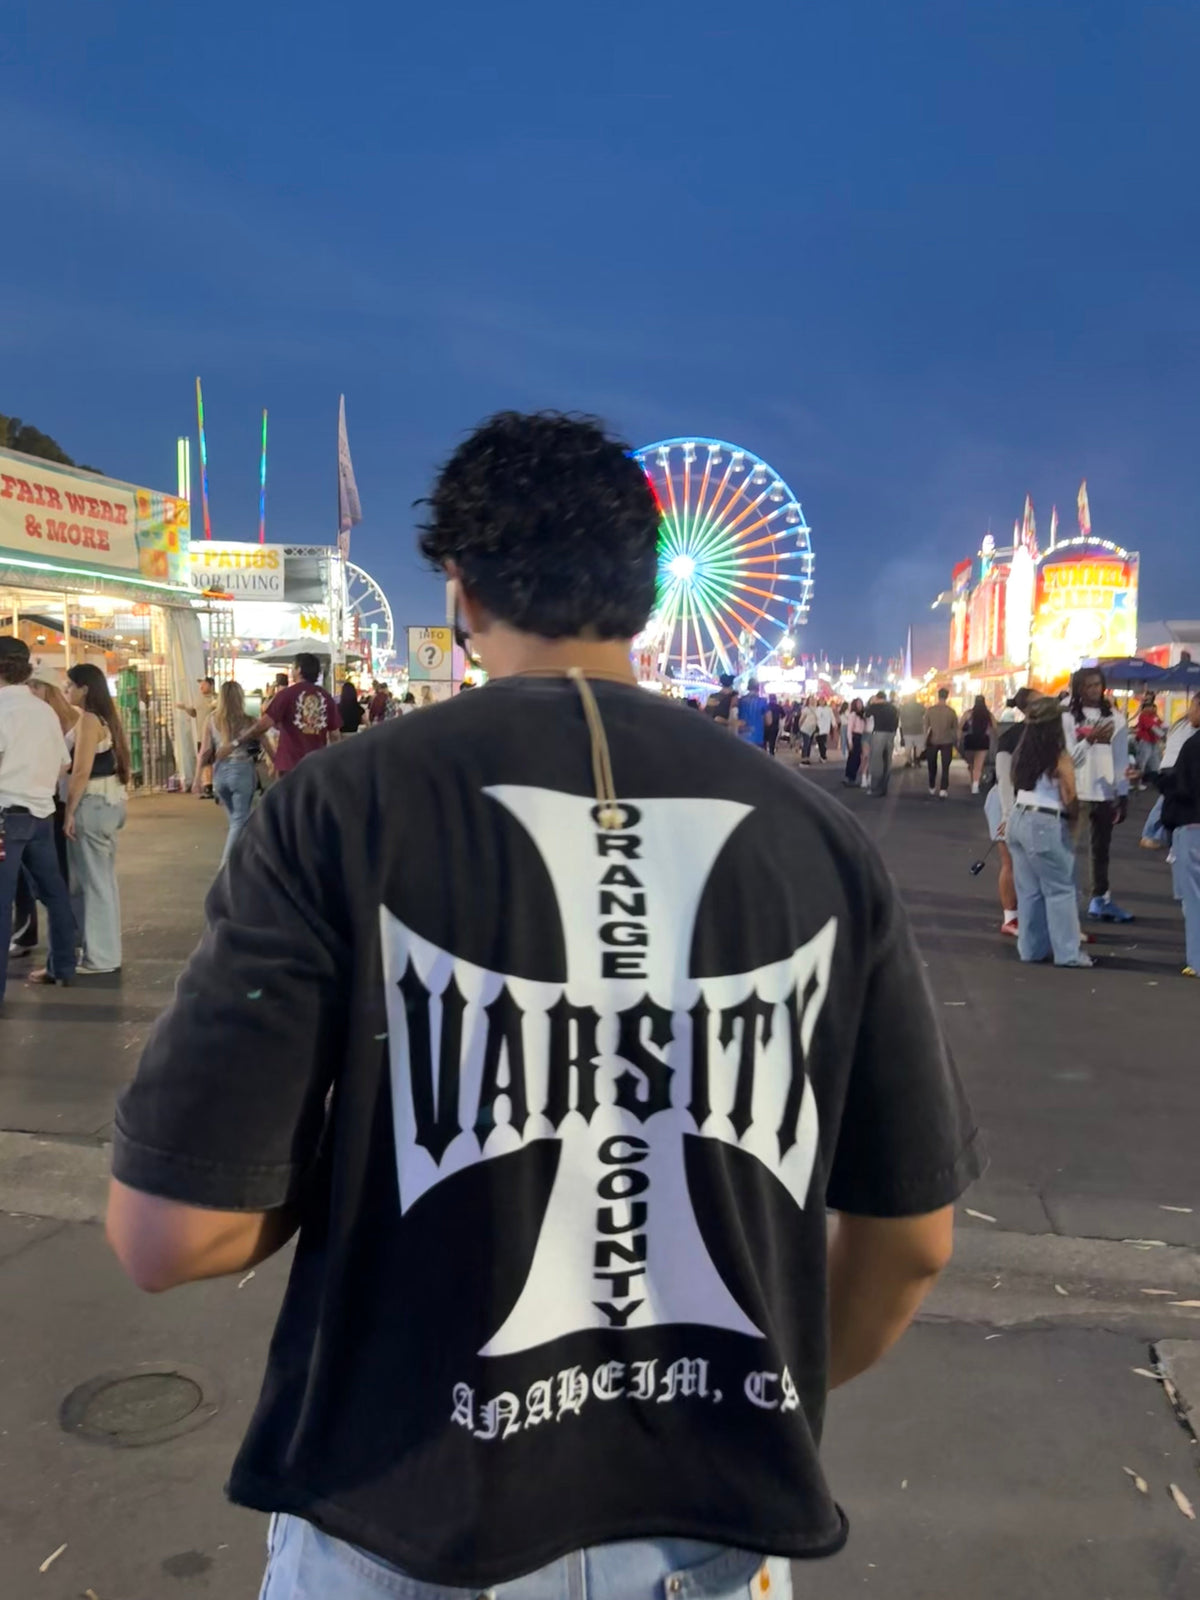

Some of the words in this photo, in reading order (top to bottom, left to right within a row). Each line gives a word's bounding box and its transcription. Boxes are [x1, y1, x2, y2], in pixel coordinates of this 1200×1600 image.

[1, 473, 63, 510] FAIR
[64, 490, 128, 525] WEAR
[25, 514, 42, 539] &
[46, 518, 110, 551] MORE
[204, 549, 279, 570] PATIOS
[1044, 563, 1124, 589] FUNNEL
[226, 574, 279, 591] LIVING
[419, 631, 444, 639] INFO
[590, 803, 648, 979] ORANGE
[396, 950, 820, 1169] VARSITY
[592, 1135, 650, 1327] COUNTY
